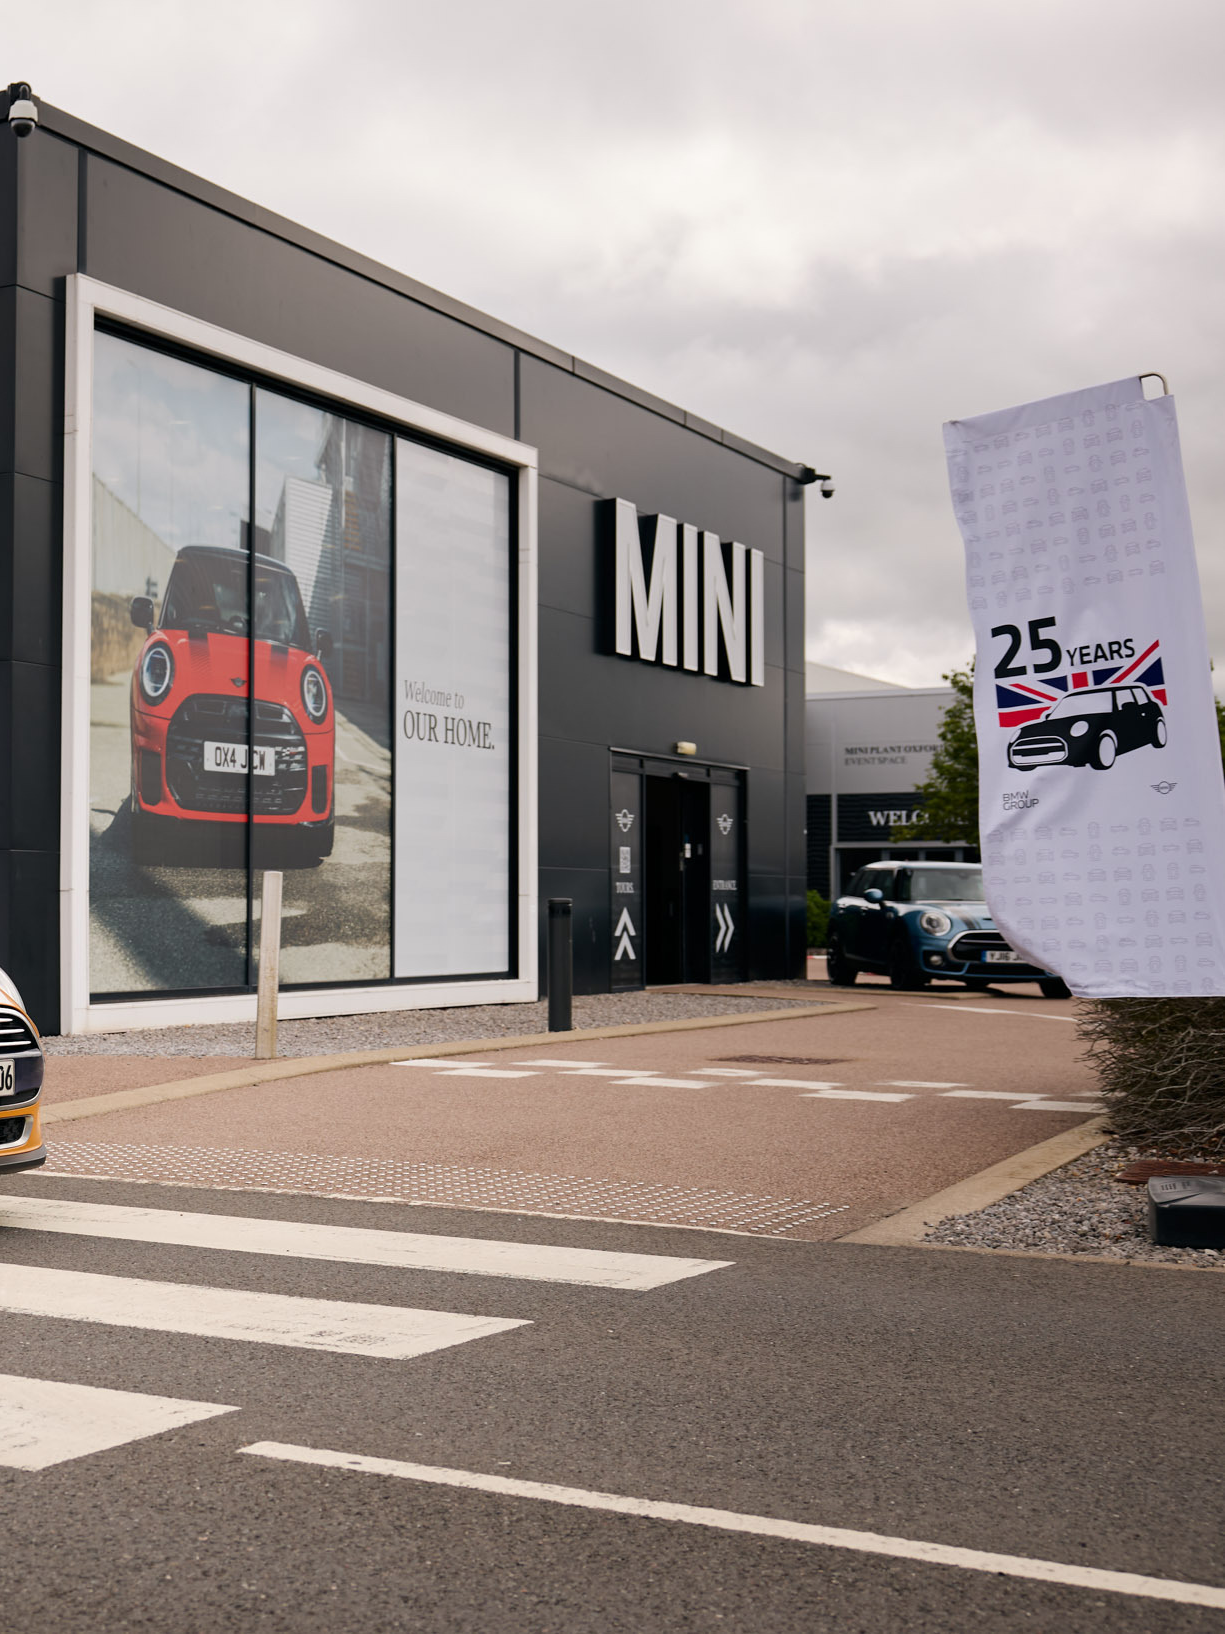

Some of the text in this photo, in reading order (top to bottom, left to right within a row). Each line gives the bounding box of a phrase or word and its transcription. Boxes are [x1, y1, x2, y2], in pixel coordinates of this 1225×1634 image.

[616, 497, 765, 687] MINI
[991, 616, 1135, 679] 25 YEARS
[404, 680, 465, 709] Welcome to
[403, 710, 495, 750] OUR HOME.
[215, 746, 237, 768] OX4
[1003, 790, 1029, 802] BMW
[1003, 798, 1039, 811] GROUP
